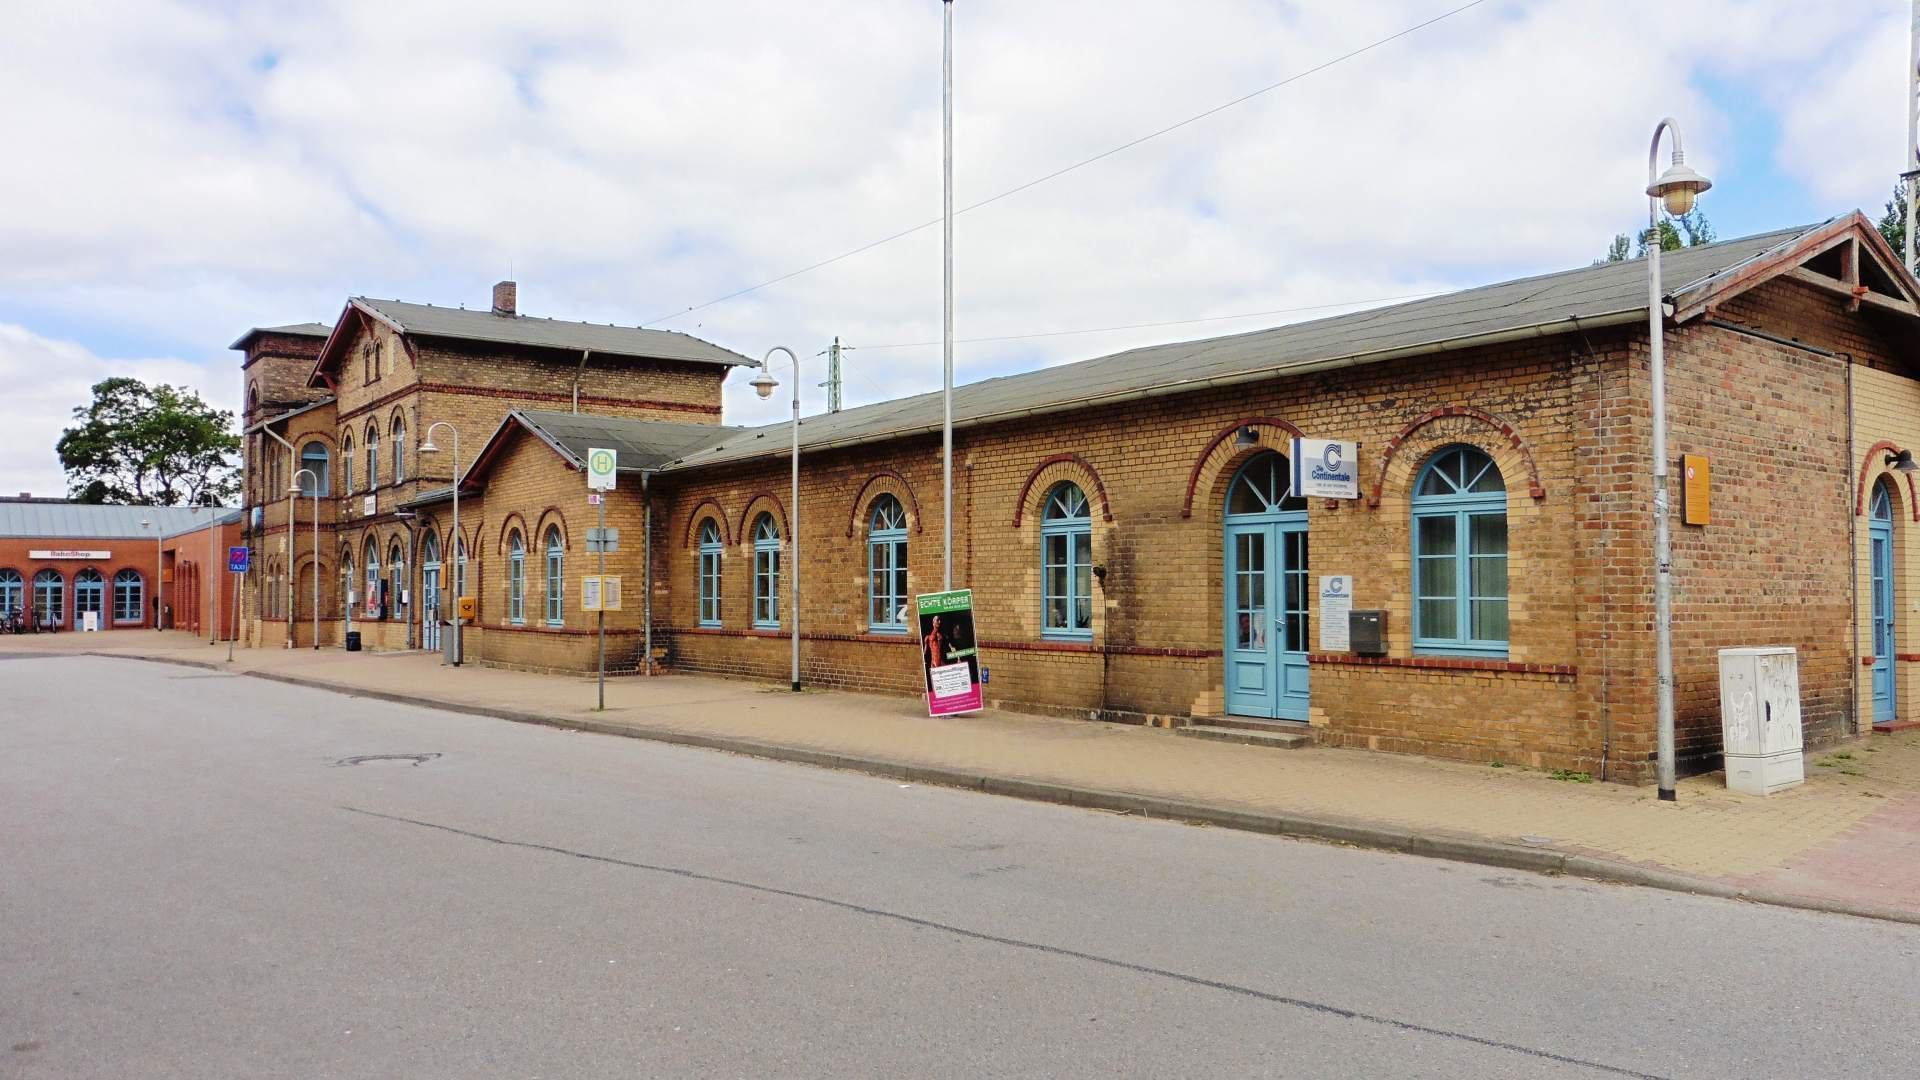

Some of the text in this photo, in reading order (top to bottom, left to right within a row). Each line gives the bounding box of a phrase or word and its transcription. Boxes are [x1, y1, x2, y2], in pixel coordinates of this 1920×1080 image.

[597, 456, 608, 470] H
[1312, 471, 1350, 481] Continentale
[920, 599, 941, 609] ECHTE
[943, 596, 969, 606] KÖRPER
